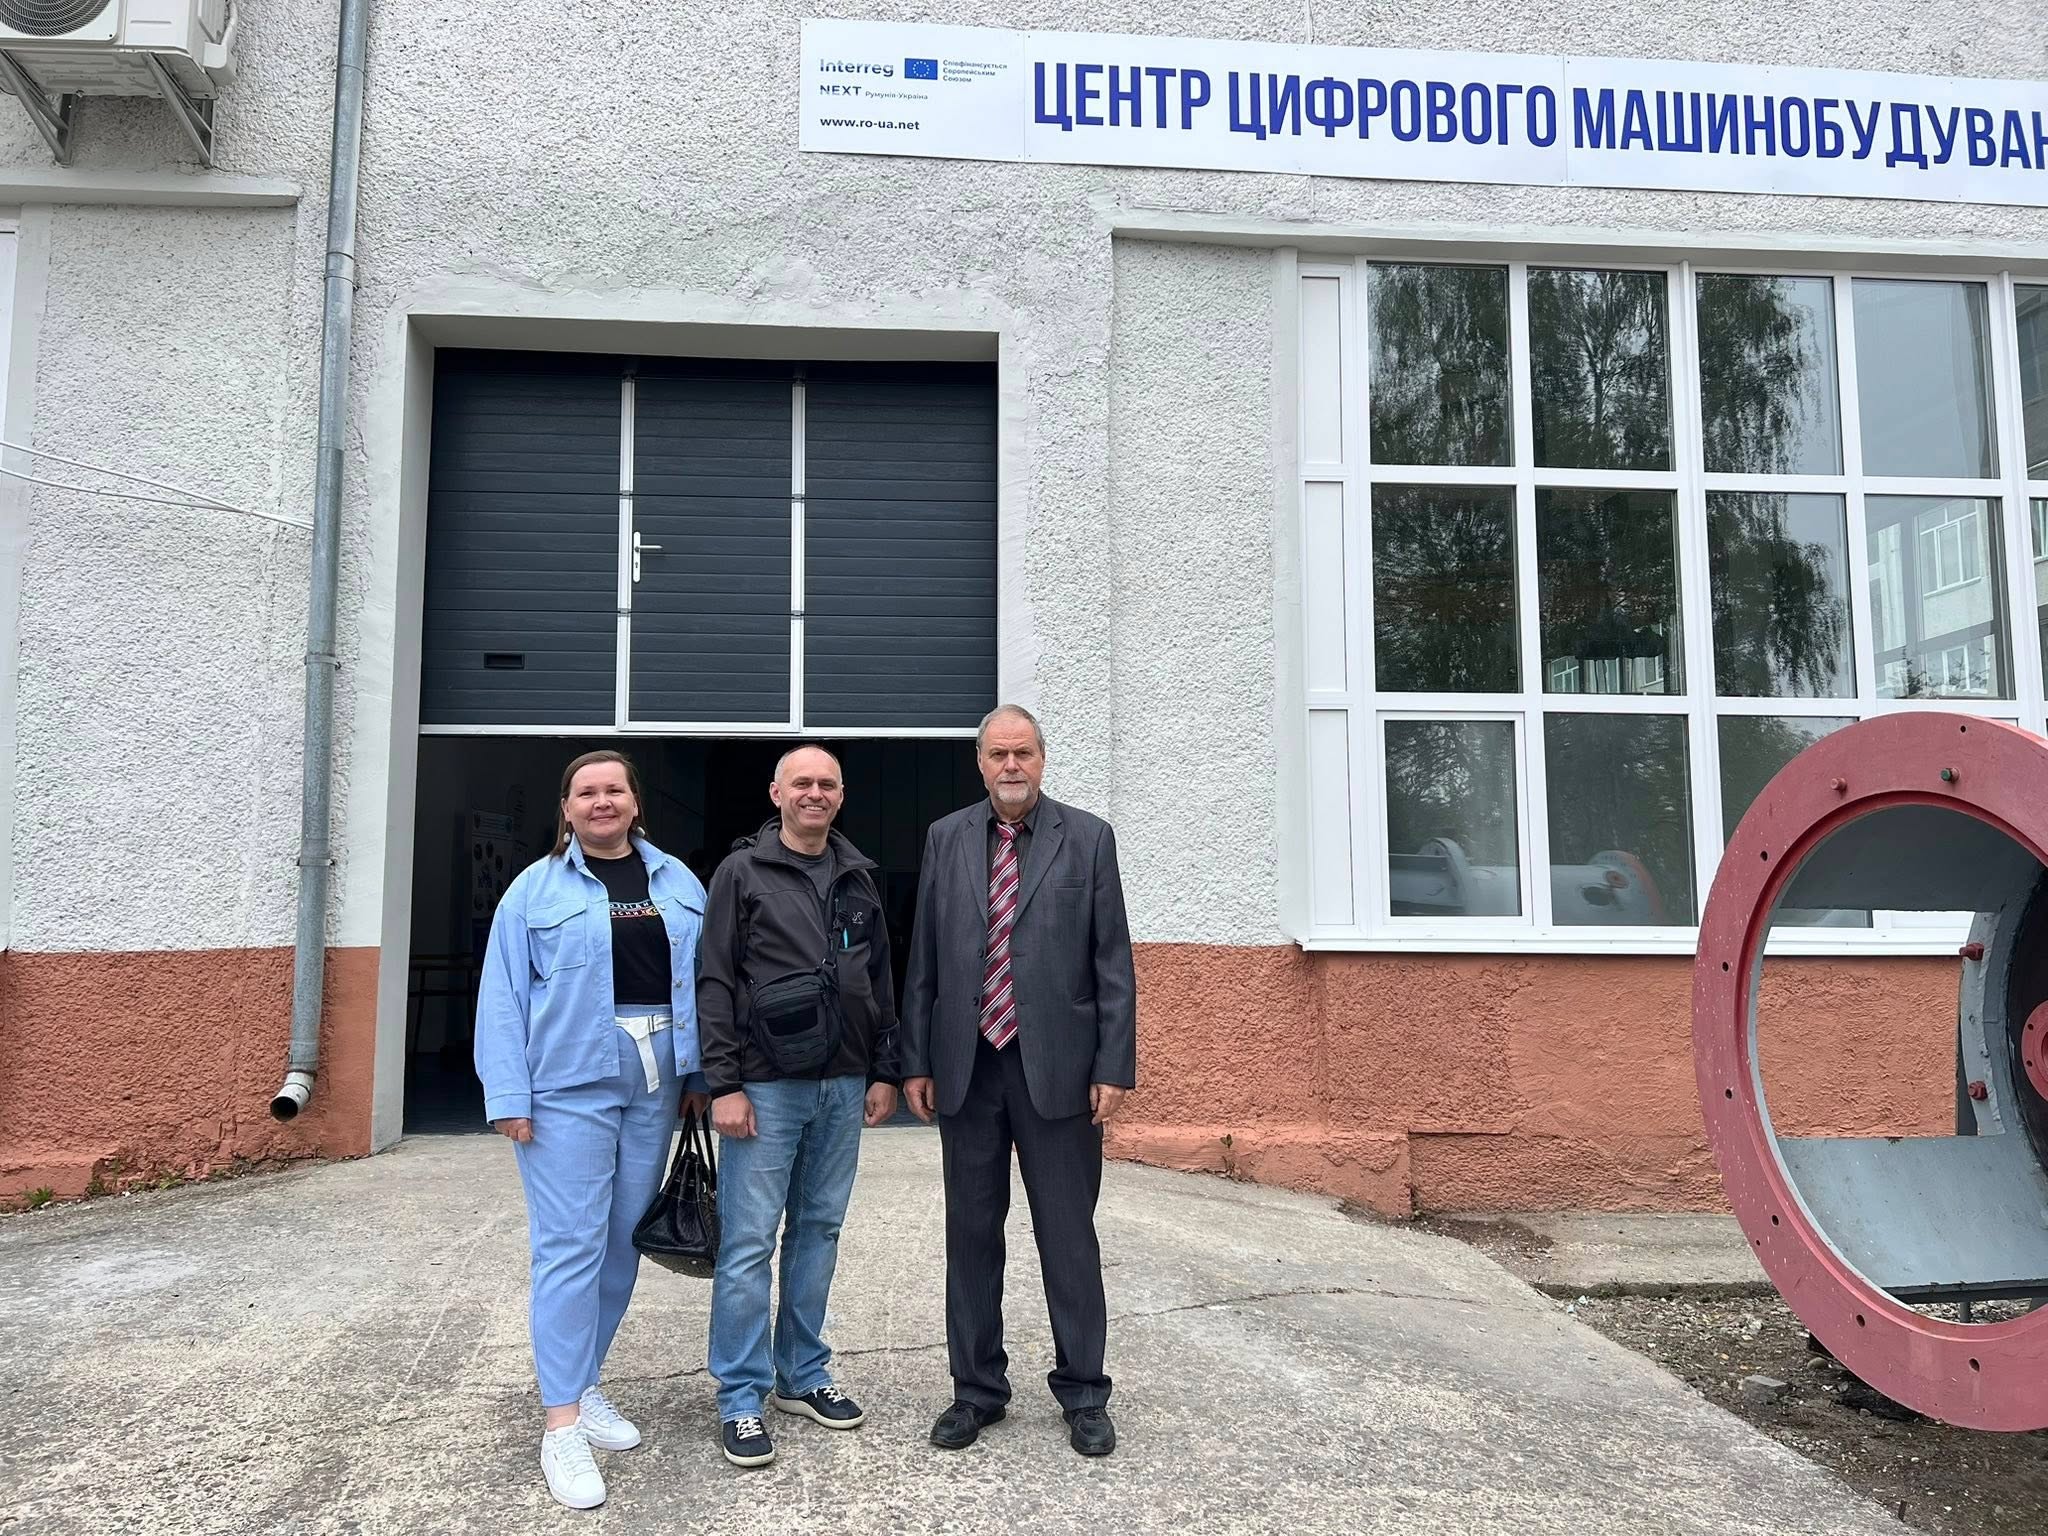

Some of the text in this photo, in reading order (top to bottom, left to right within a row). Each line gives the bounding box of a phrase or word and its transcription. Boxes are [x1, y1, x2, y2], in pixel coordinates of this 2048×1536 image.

[820, 59, 894, 77] Interreg
[942, 75, 972, 83] Союзом
[820, 85, 862, 97] NEXT
[1035, 63, 1210, 131] ЦЕНТР
[1229, 72, 1556, 147] ЦИФРОВОГО
[820, 118, 919, 131] www.ro-ua.net
